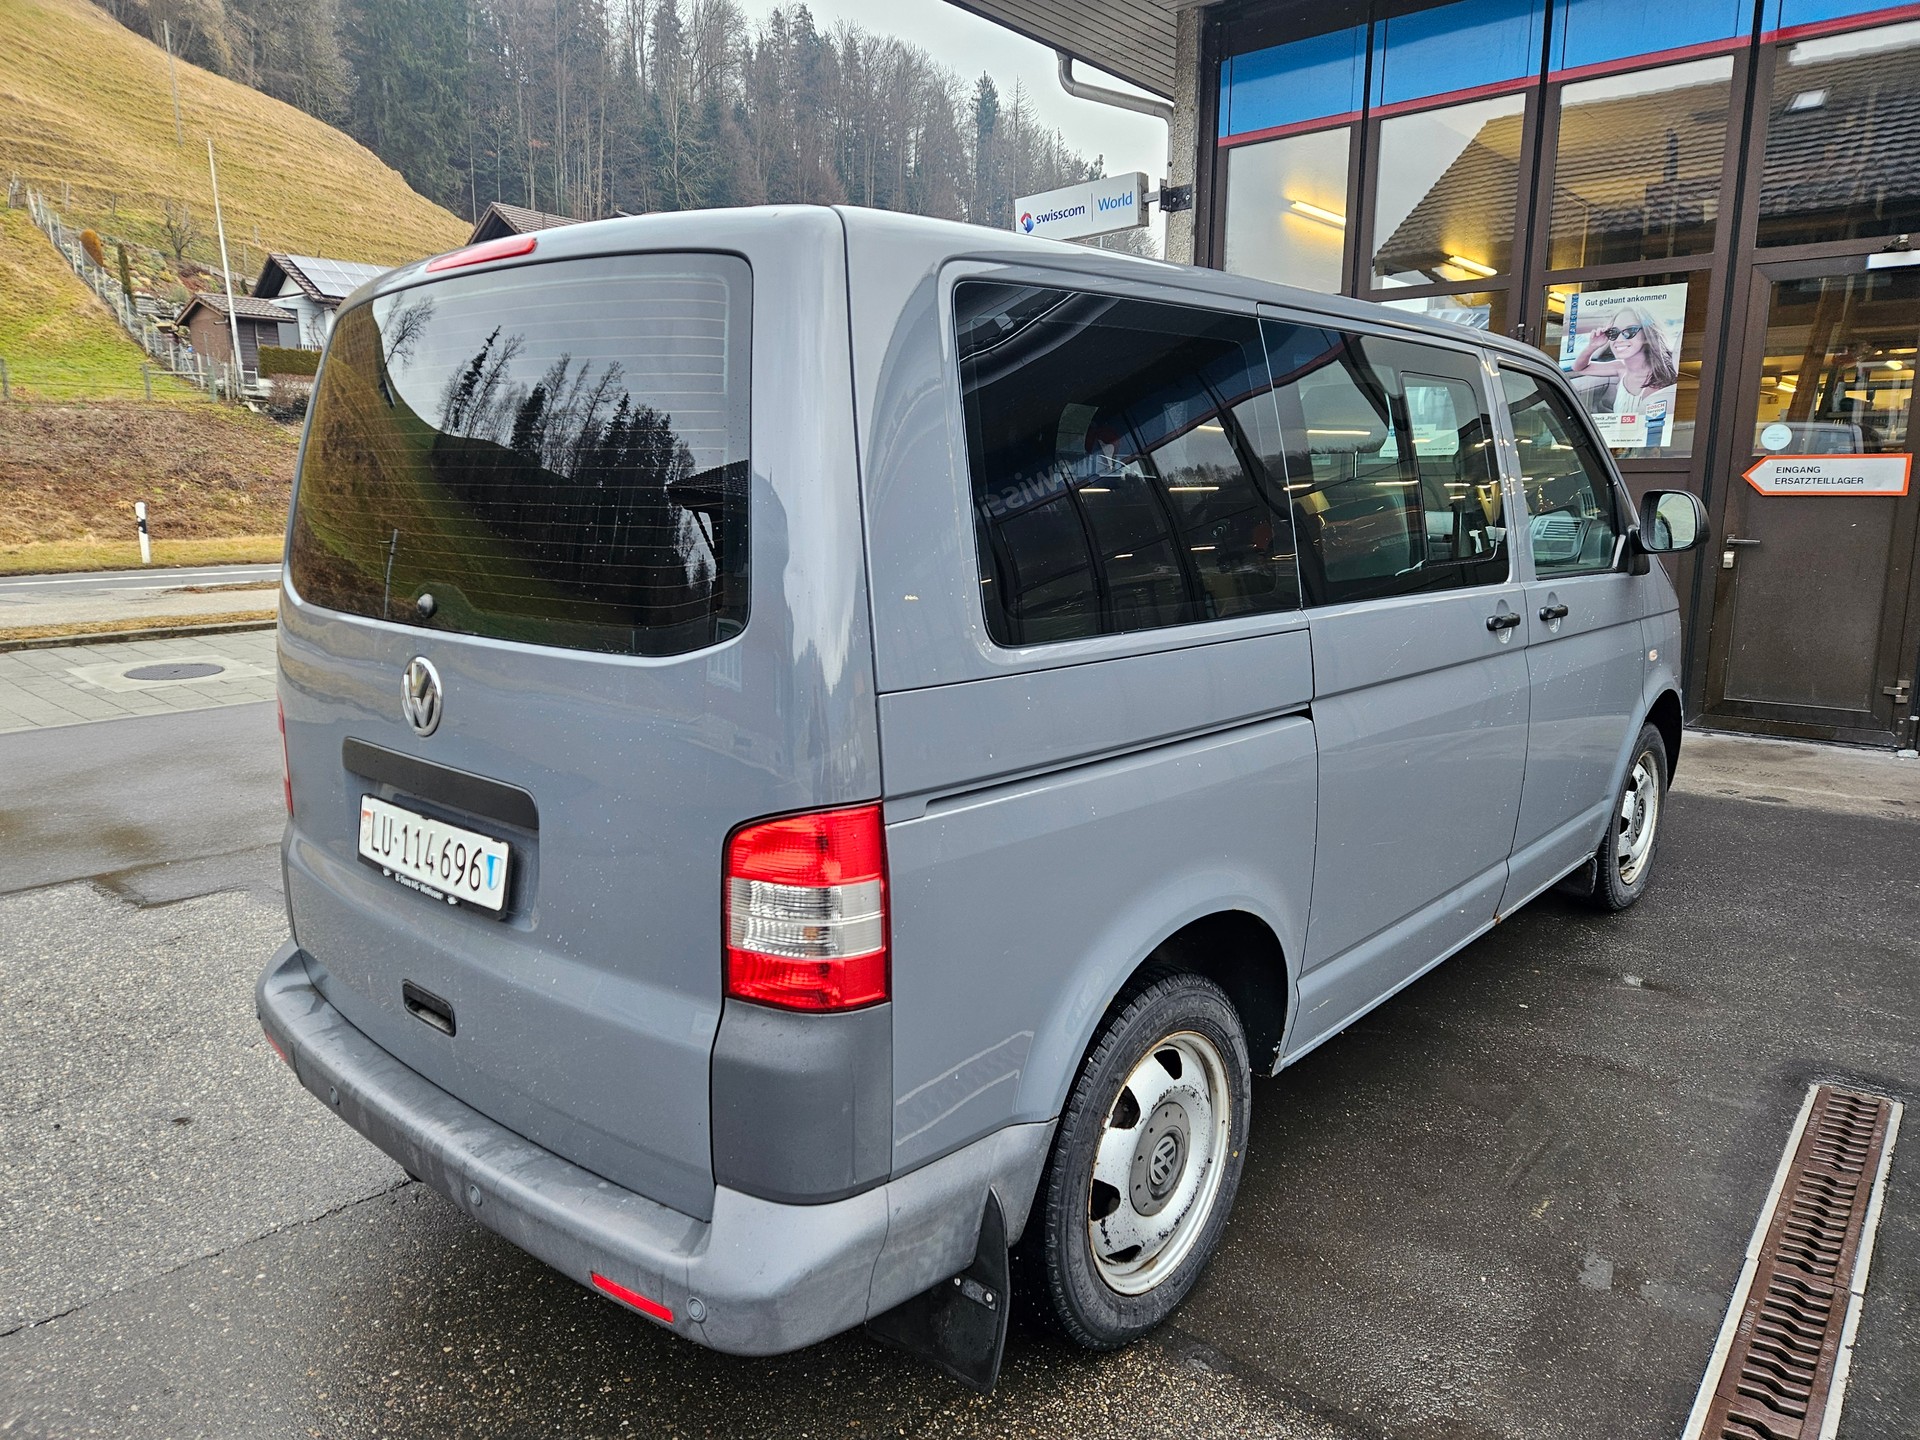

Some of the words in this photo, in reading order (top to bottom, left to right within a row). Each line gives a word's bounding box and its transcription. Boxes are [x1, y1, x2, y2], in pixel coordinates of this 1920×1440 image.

[1036, 204, 1085, 224] swisscom
[1098, 191, 1133, 212] World
[1599, 296, 1625, 307] gelaunt
[1627, 293, 1667, 303] ankommen
[1776, 466, 1821, 474] EINGANG
[1774, 477, 1864, 485] ERSATZTEILLAGER
